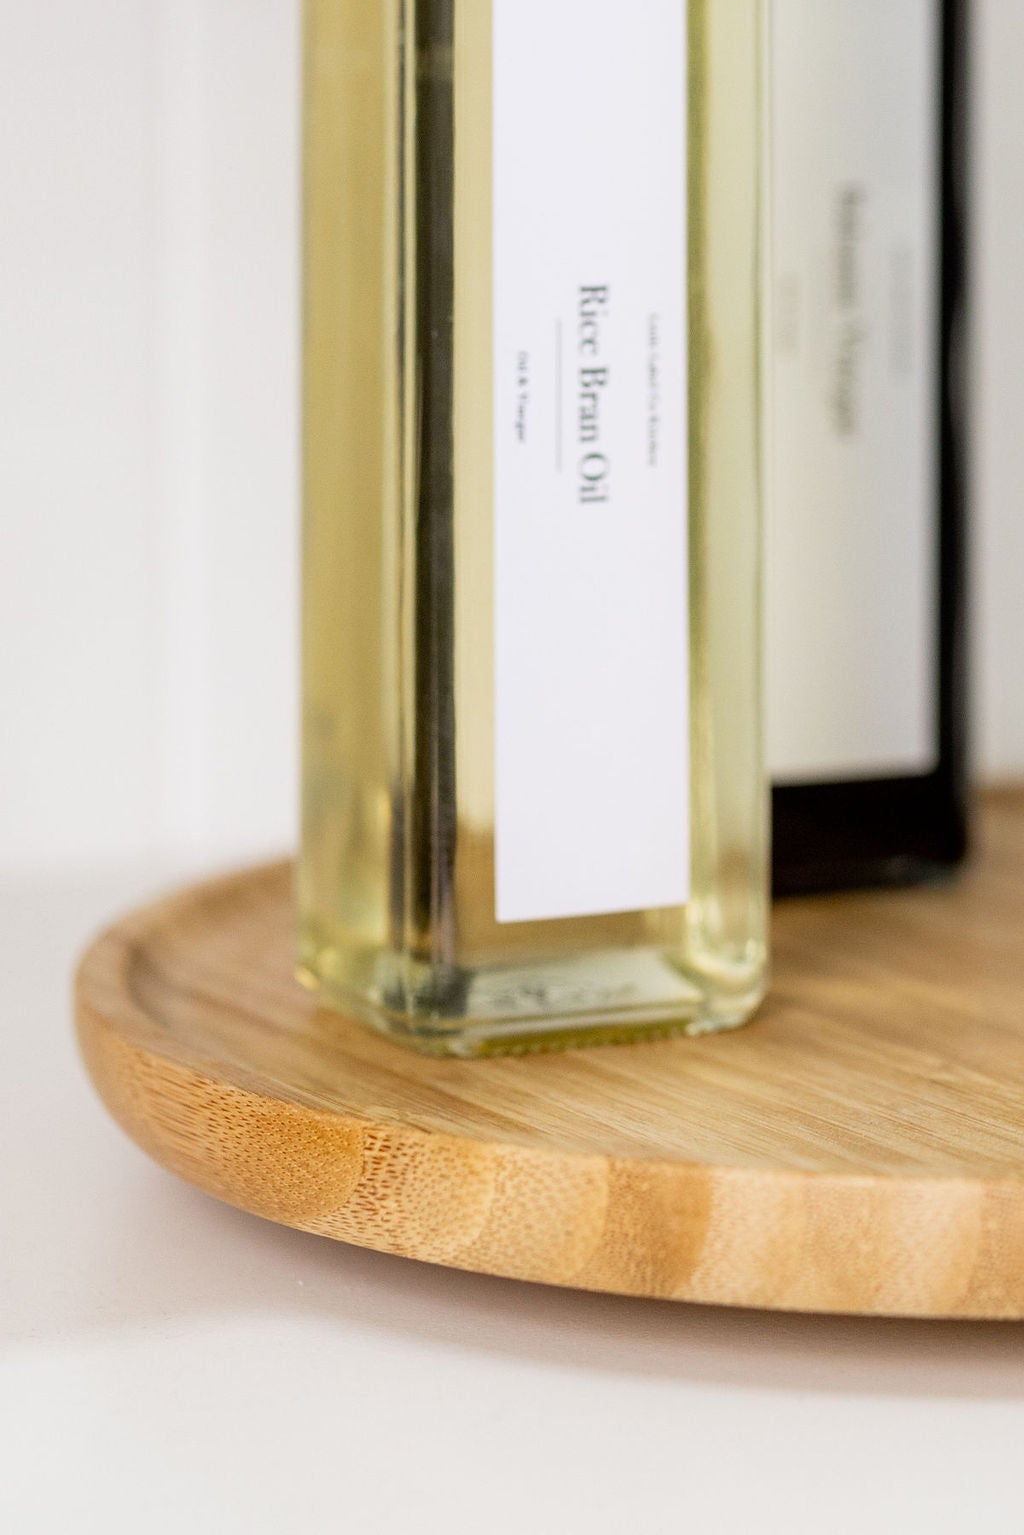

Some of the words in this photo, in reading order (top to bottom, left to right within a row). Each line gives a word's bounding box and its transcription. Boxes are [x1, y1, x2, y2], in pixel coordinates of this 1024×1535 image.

[579, 284, 608, 356] Rice
[579, 366, 608, 444] Bran
[579, 452, 609, 504] Oil
